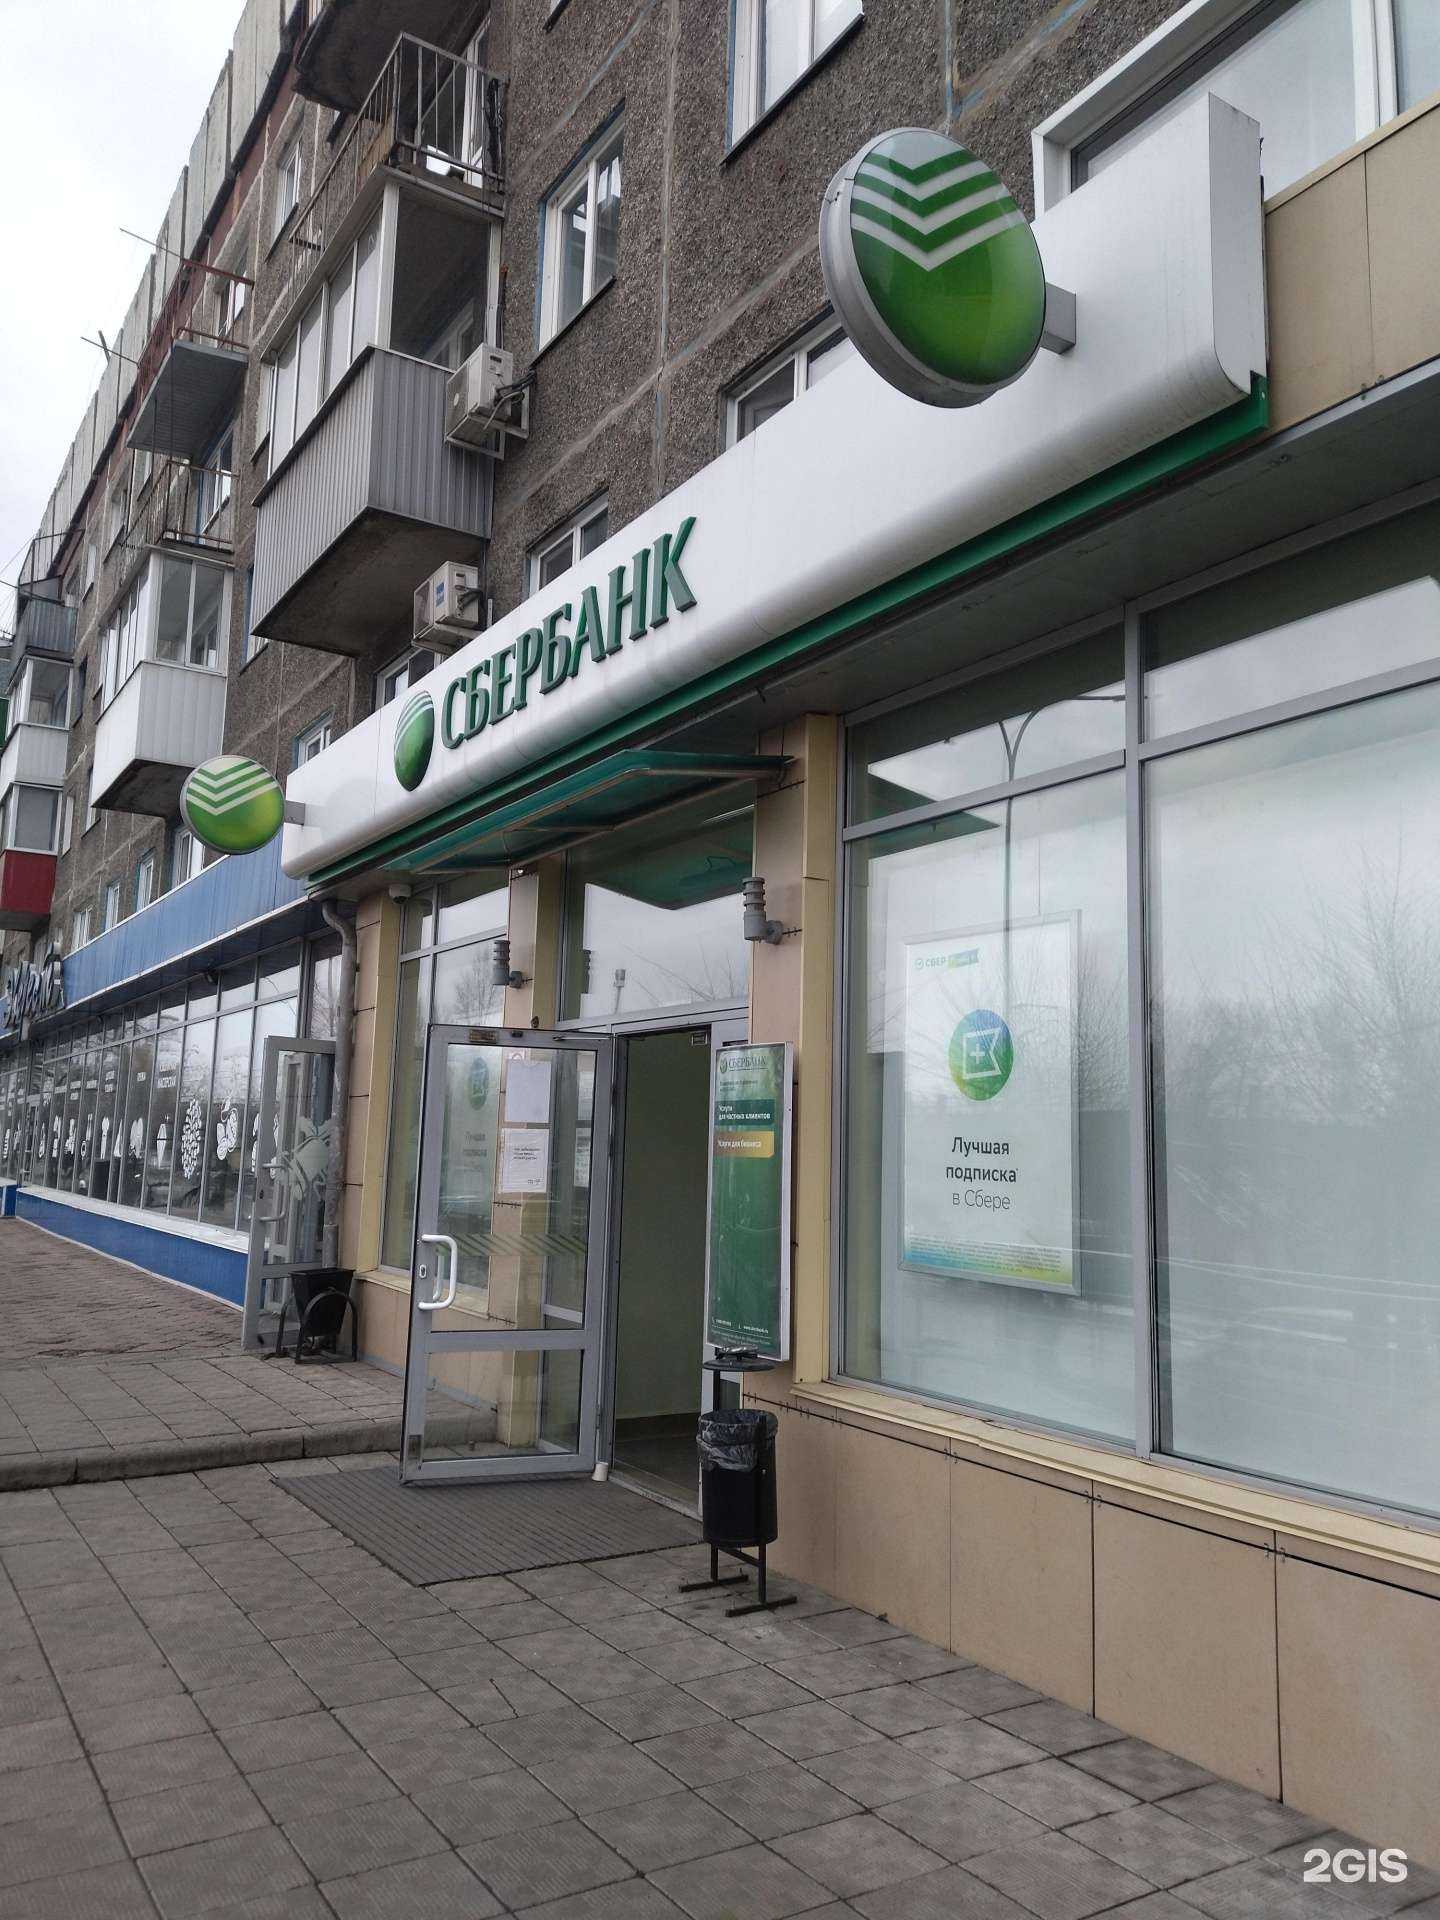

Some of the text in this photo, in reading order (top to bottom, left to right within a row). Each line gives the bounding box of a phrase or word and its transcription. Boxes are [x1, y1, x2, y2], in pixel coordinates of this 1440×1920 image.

[441, 516, 697, 749] СБЕРБАНК
[952, 1137, 1009, 1157] Лучшая
[952, 1189, 1011, 1212] в Сбере
